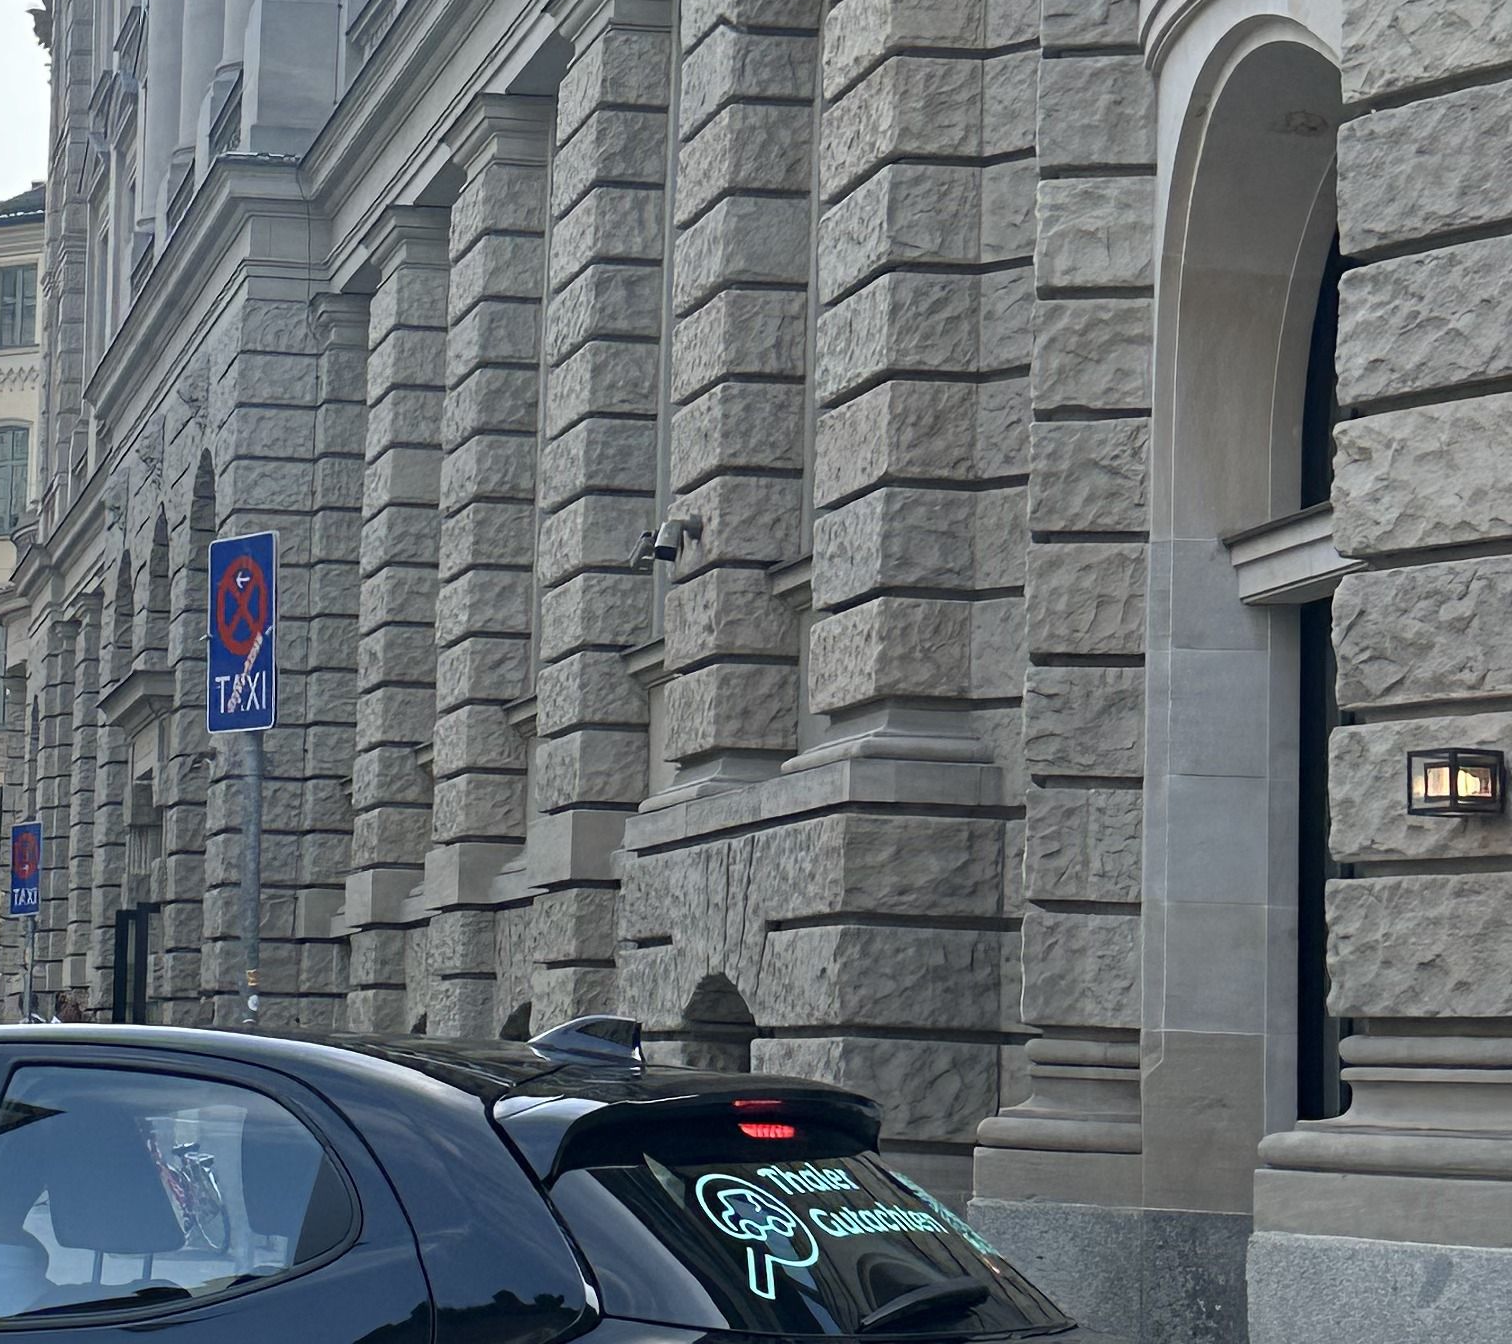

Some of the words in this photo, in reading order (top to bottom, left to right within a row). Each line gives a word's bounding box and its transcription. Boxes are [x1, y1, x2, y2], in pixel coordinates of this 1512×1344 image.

[12, 886, 38, 906] TAXI
[756, 1162, 860, 1195] Thaler
[808, 1201, 949, 1238] Gutachten
